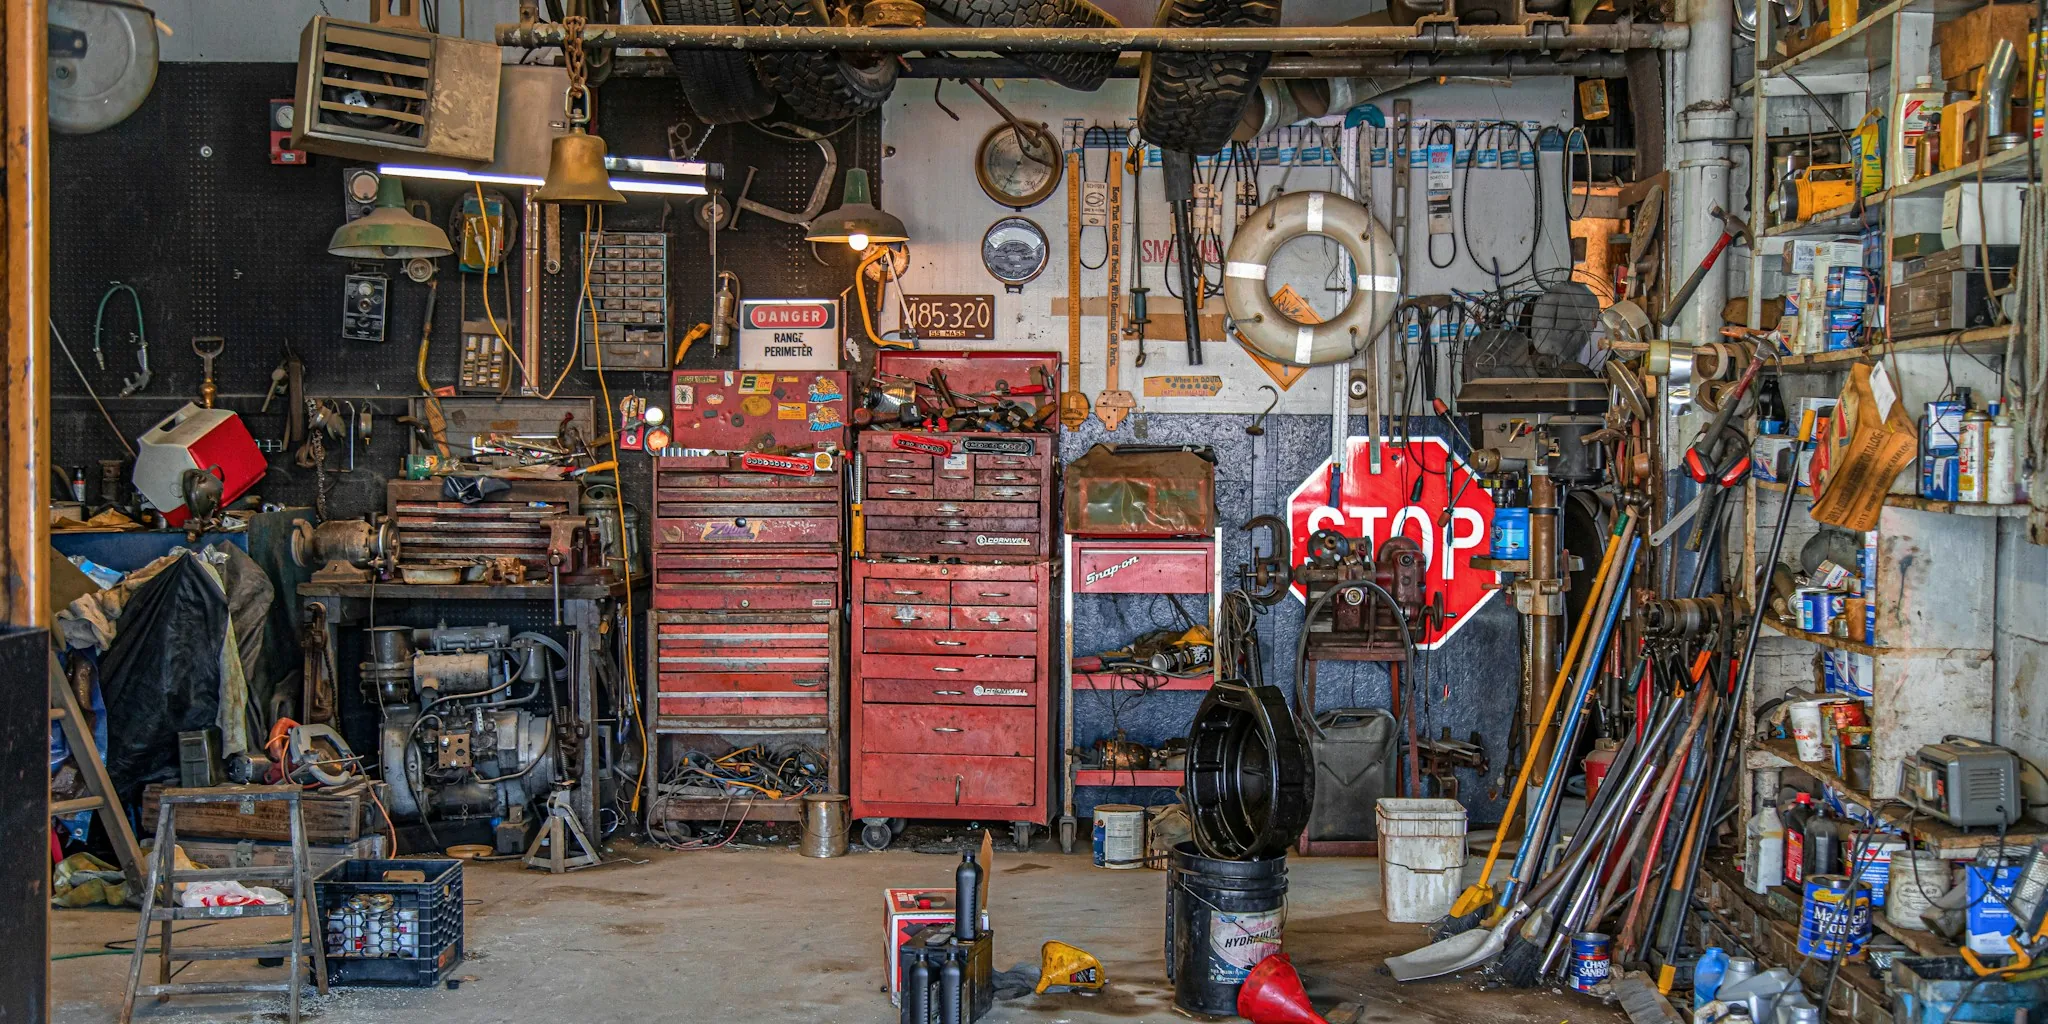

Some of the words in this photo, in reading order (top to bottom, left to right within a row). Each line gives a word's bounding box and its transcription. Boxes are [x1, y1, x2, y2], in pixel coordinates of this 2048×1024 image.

[1111, 187, 1119, 204] Keep
[1142, 240, 1224, 263] SMOING
[757, 311, 820, 323] DANGER
[774, 333, 804, 343] RANGE
[764, 346, 813, 357] PERIMETER
[987, 537, 1030, 545] CORNWELL
[1307, 506, 1484, 580] STOP
[1086, 556, 1138, 585] Snap-on
[1225, 927, 1277, 948] HYDRAULIC
[1580, 967, 1607, 977] SANBO
